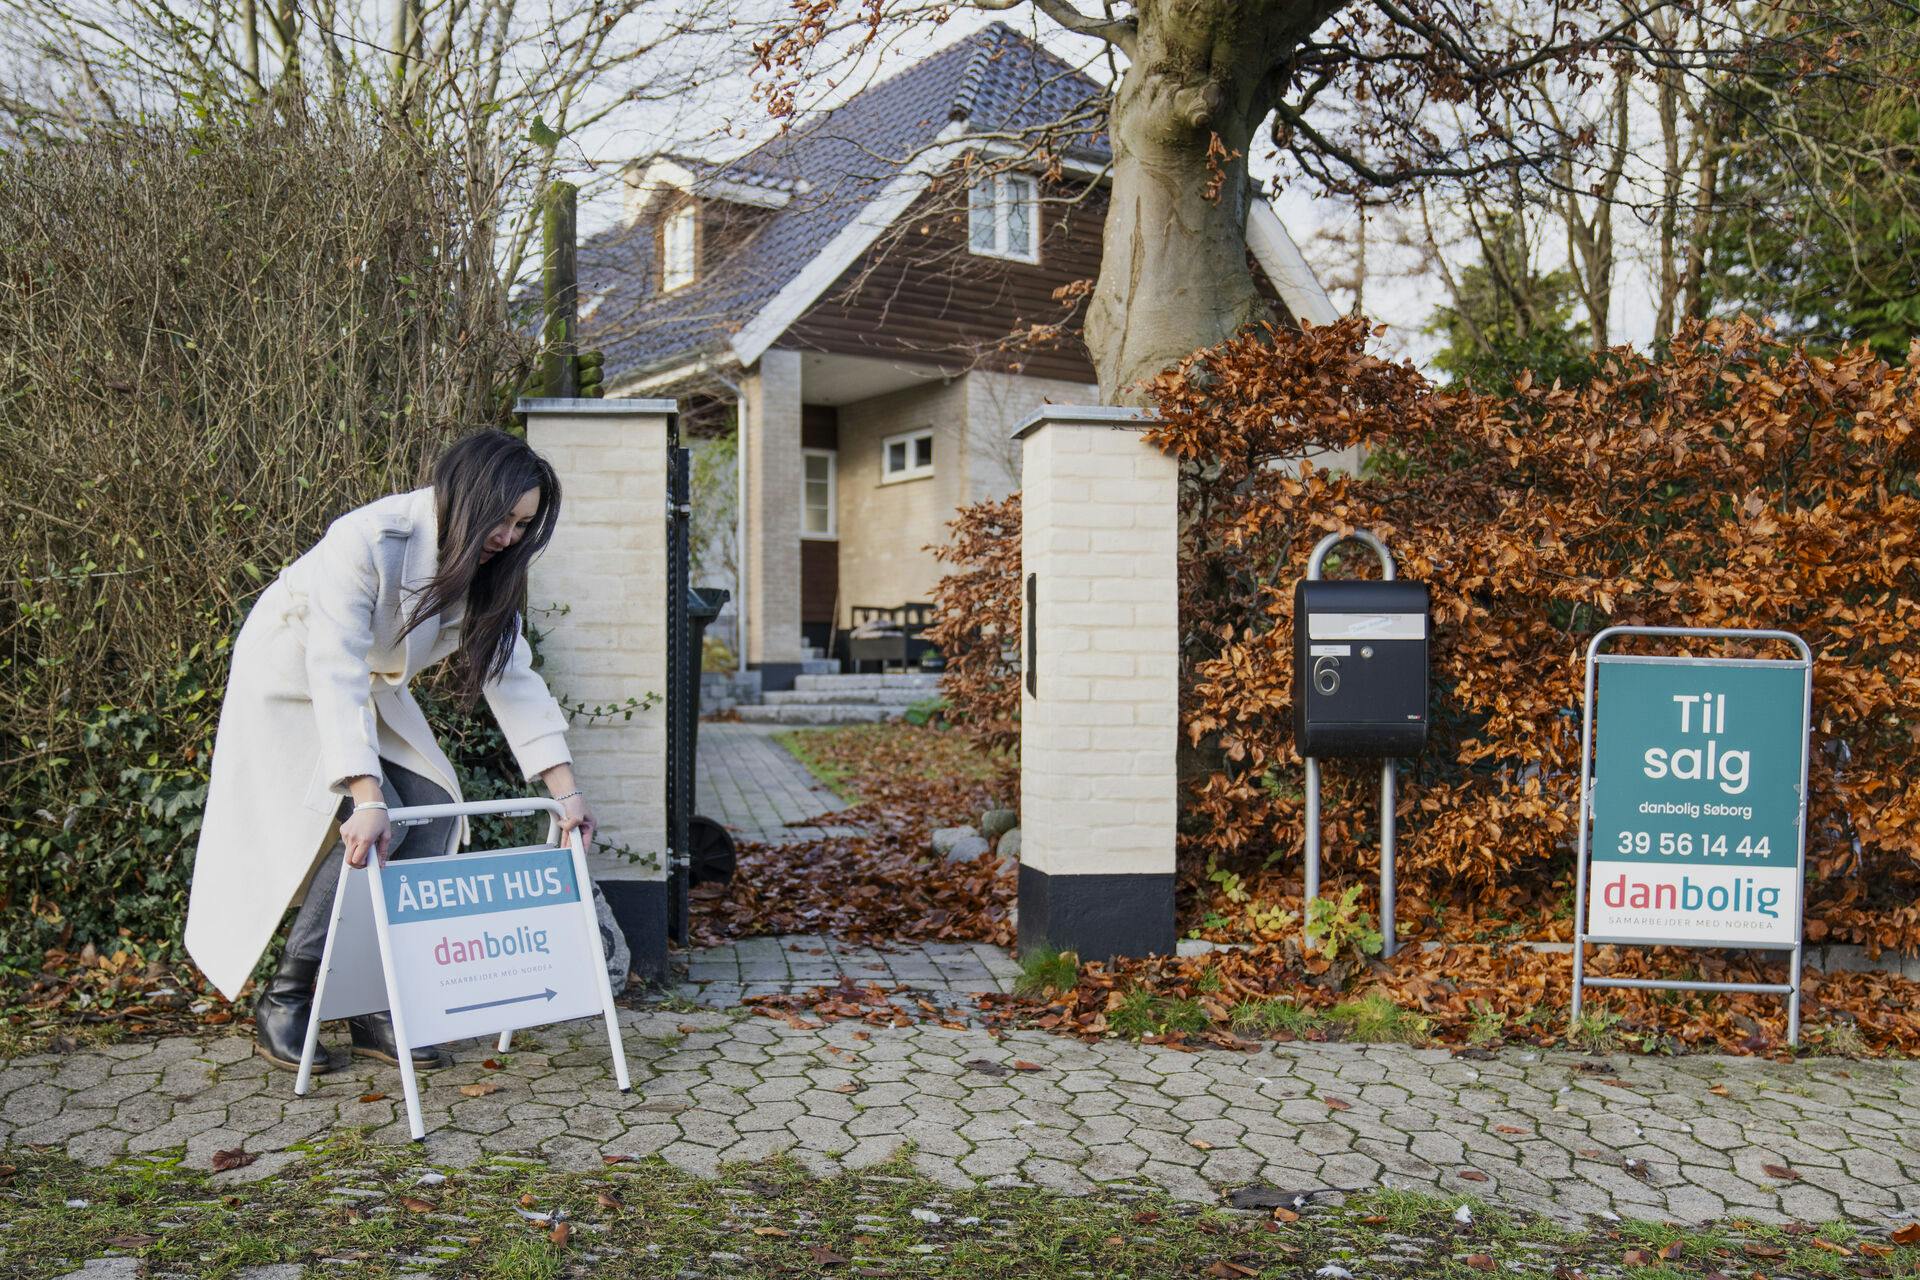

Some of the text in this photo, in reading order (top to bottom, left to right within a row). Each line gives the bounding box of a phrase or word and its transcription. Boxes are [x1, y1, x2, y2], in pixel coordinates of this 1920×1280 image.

[1313, 655, 1341, 696] 6
[1673, 692, 1725, 734] Til
[1643, 740, 1751, 795] salg
[1639, 801, 1752, 820] danbolig Søborg
[1617, 831, 1771, 858] 39 56 14 44
[397, 874, 495, 912] ÅBENT
[1603, 874, 1781, 919] danbolig
[1608, 916, 1773, 930] SAMARBEJDER MED NORDEA
[434, 926, 550, 966] danbolig
